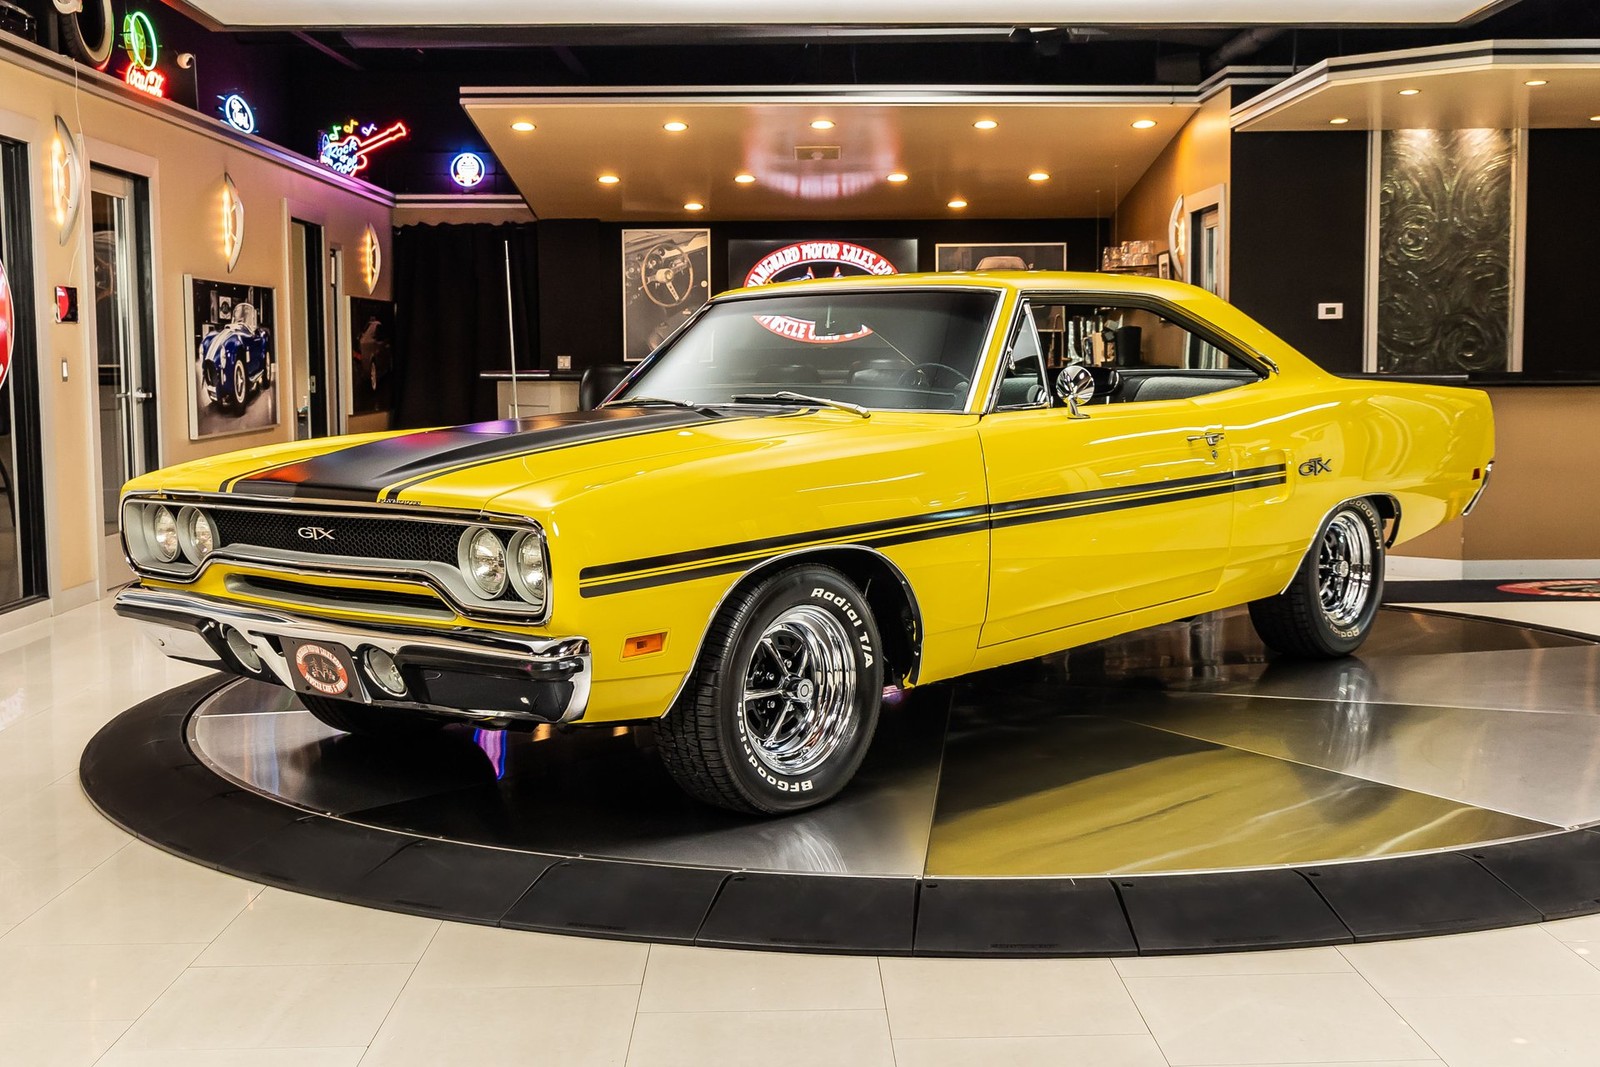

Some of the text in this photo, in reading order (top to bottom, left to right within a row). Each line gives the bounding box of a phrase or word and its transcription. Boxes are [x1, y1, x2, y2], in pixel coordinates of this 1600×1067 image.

[329, 138, 358, 158] Rock
[800, 243, 840, 260] MOTOR
[841, 244, 896, 275] SALES.CO
[1298, 457, 1332, 476] GTX
[298, 526, 336, 540] GTX
[810, 588, 873, 668] Radial T/A
[737, 702, 813, 792] BFGoodrich
